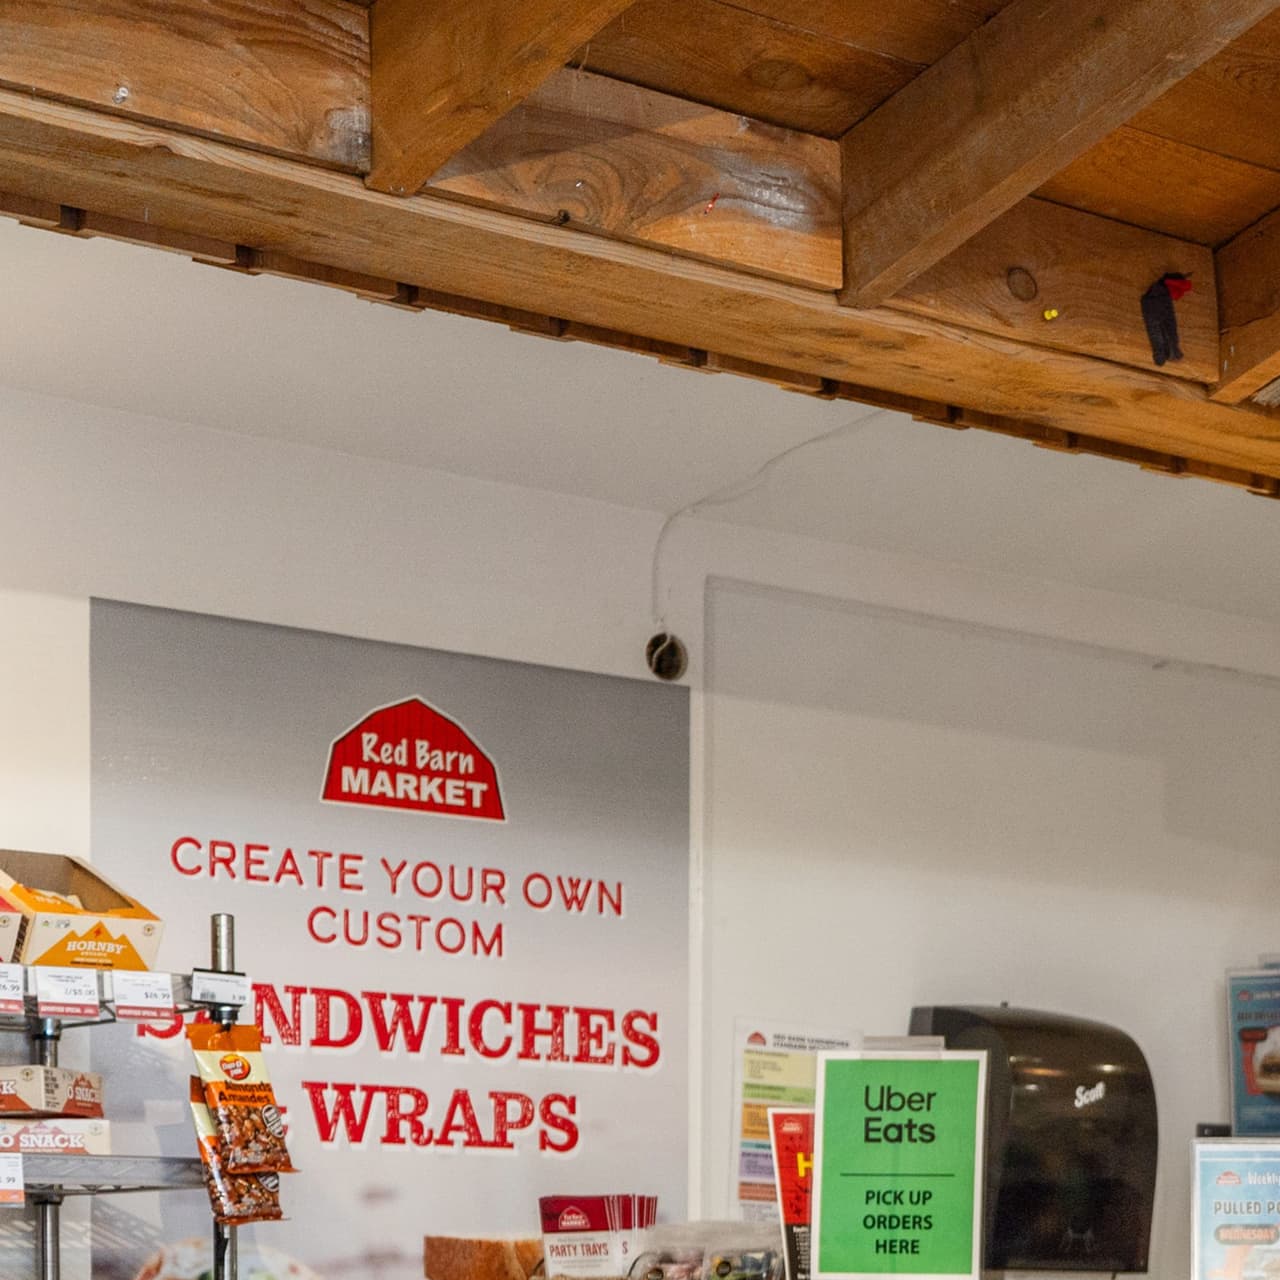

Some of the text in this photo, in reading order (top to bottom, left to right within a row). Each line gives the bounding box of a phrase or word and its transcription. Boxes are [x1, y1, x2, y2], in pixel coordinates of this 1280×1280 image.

[362, 731, 475, 775] Red Barn
[340, 766, 489, 809] MARKET
[170, 836, 624, 916] CREATE YOUR OWN
[307, 905, 504, 957] CUSTOM
[136, 983, 662, 1069] NDWICHES
[863, 1085, 937, 1112] Uber
[301, 1079, 580, 1153] WRAPS
[863, 1117, 936, 1144] Eats
[864, 1189, 933, 1206] PICK UP
[1214, 1200, 1262, 1215] PULLED
[862, 1213, 933, 1231] ORDERS
[549, 1242, 609, 1257] PARTY TRAYS
[874, 1239, 920, 1255] HERE
